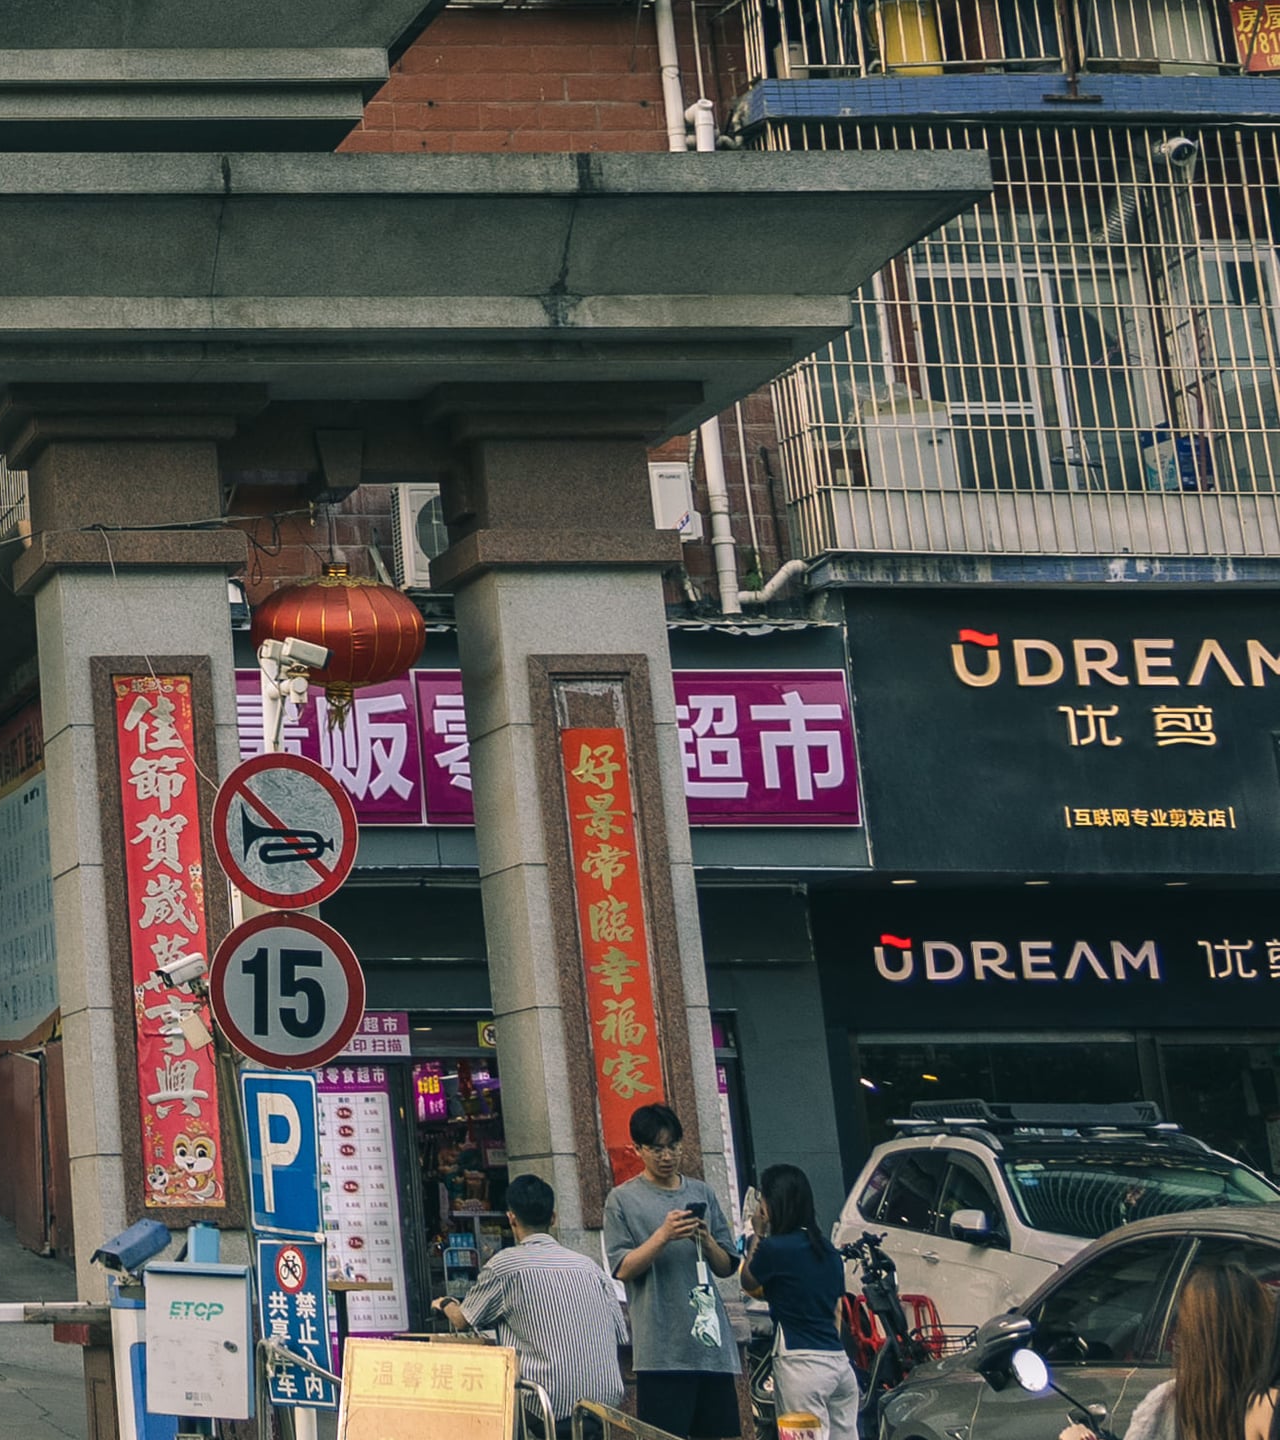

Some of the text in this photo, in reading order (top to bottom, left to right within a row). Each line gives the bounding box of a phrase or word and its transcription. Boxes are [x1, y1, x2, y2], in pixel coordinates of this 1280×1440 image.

[677, 691, 846, 801] 超市
[1057, 704, 1217, 748] 优剪
[1072, 805, 1228, 830] 互联网专业剪发店
[873, 933, 1160, 982] UDREAM
[1198, 937, 1280, 979] 优
[241, 948, 326, 1039] 15
[363, 1016, 399, 1033] 超市
[372, 1038, 403, 1053] 扫描
[257, 1091, 302, 1215] P
[169, 1301, 224, 1321] ETCP
[295, 1291, 324, 1400] 禁止入内
[372, 1360, 484, 1393] 温馨提示
